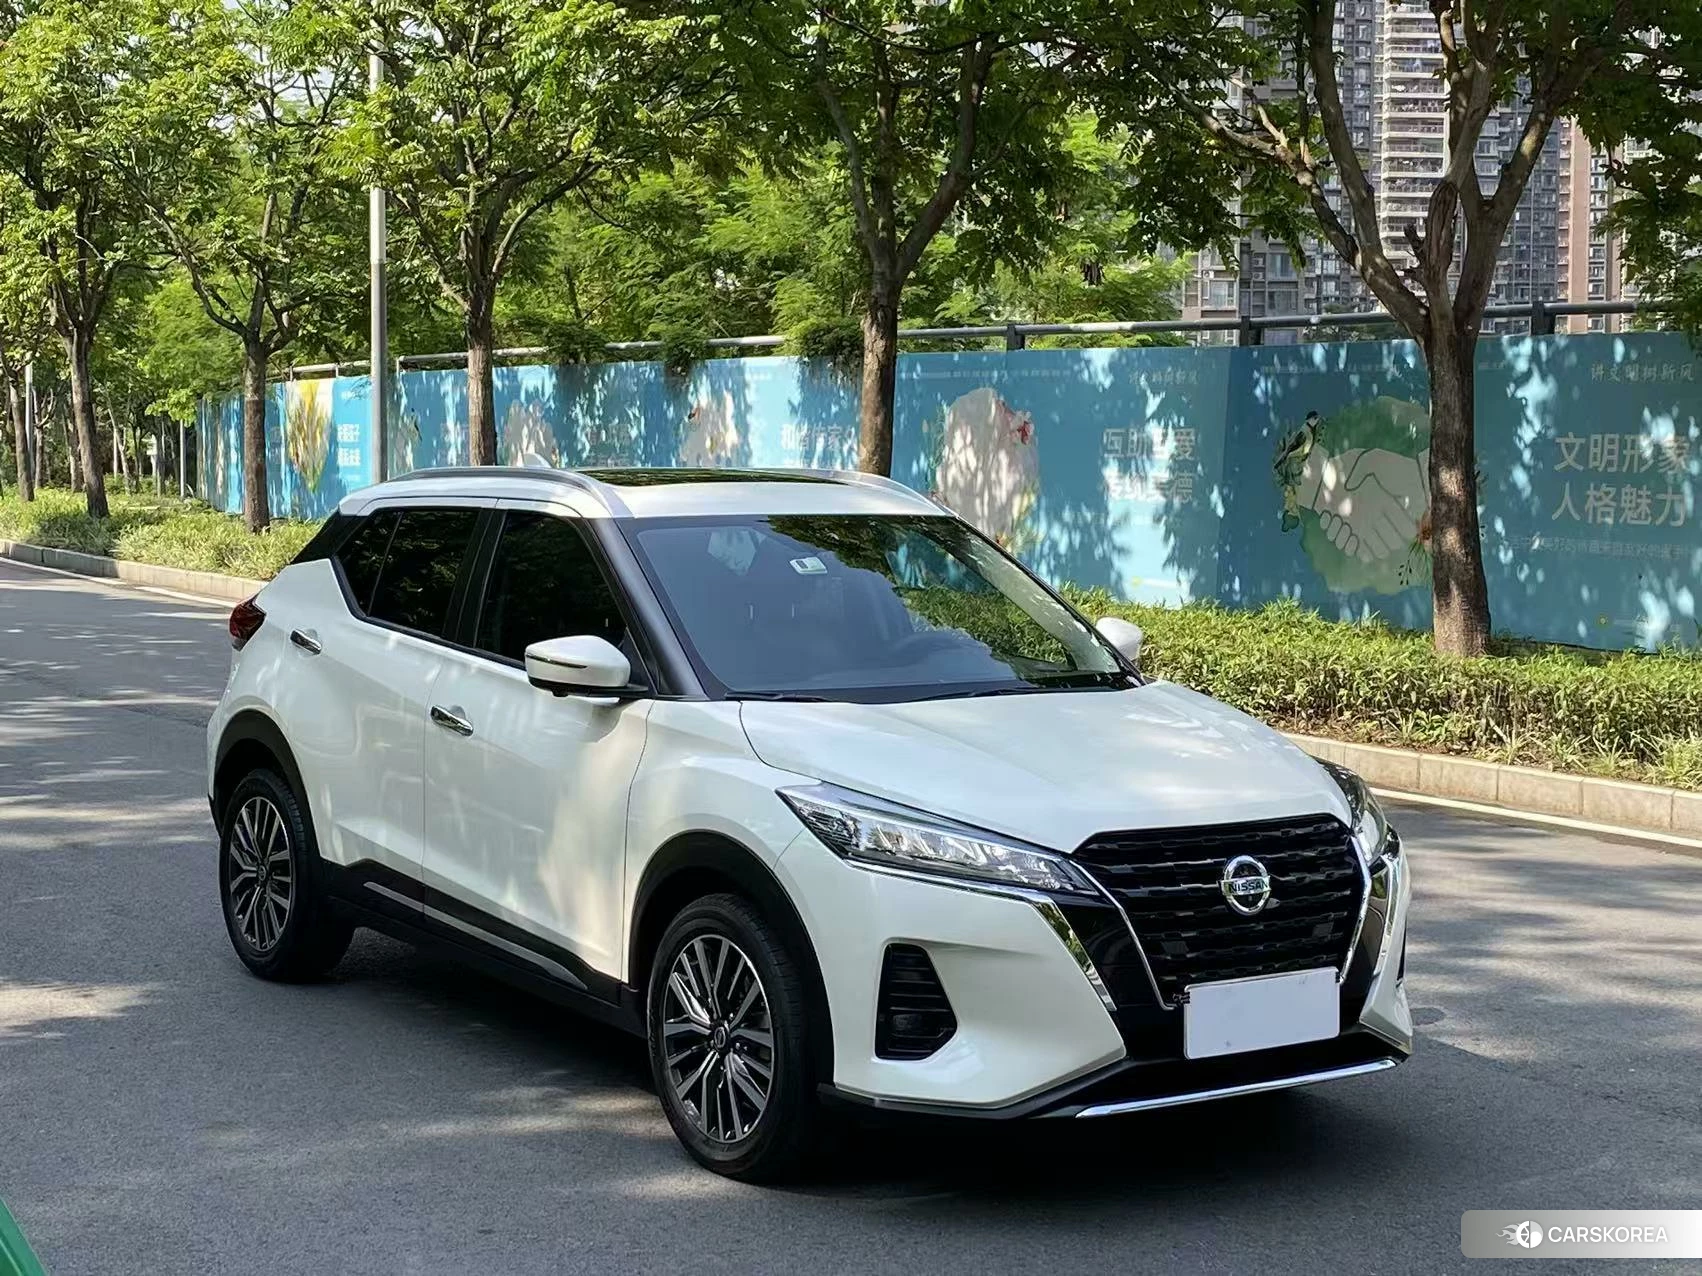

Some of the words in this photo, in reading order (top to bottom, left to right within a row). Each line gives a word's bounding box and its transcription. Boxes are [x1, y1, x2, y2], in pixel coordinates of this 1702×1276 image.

[1554, 431, 1691, 475] 文明形象
[1551, 481, 1687, 527] 人格魅力
[1228, 881, 1268, 893] NISSAN
